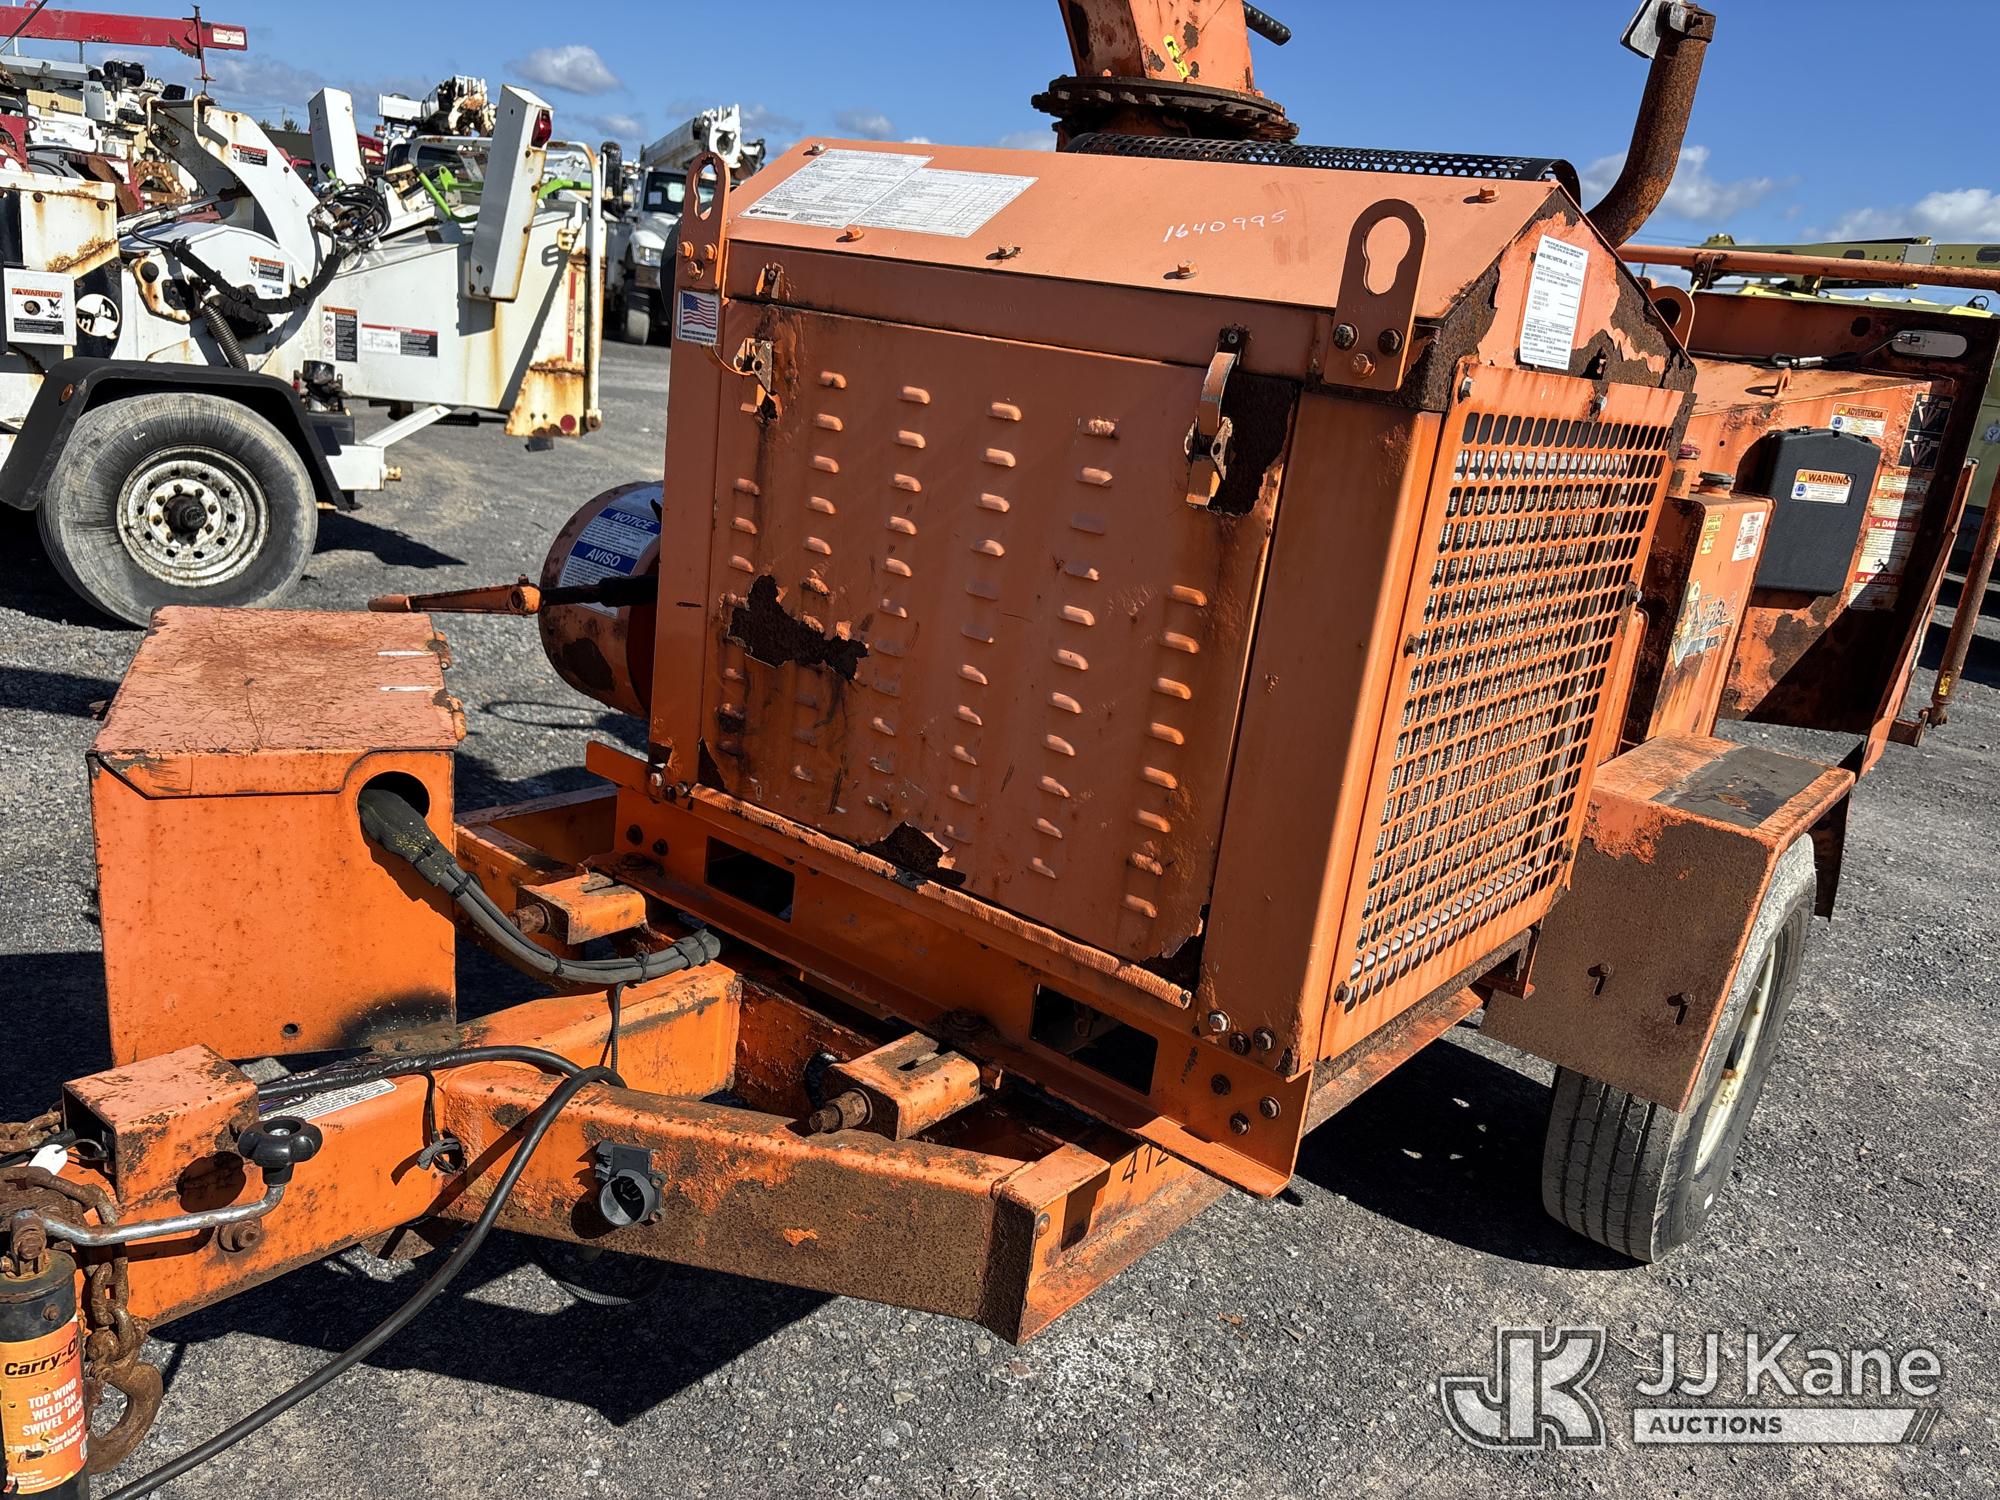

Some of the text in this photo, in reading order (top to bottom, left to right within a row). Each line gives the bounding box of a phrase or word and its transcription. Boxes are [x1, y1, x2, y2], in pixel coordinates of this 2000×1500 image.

[1162, 209, 1287, 242] 1640995
[1847, 407, 1883, 419] ADVERTENCIA
[611, 512, 655, 530] NOTICE
[1882, 519, 1912, 529] DANGER
[585, 548, 621, 567] AVISO
[28, 1378, 77, 1409] TOP WIND
[32, 1391, 77, 1422] WELD-ON
[22, 1416, 63, 1437] SWIVEL
